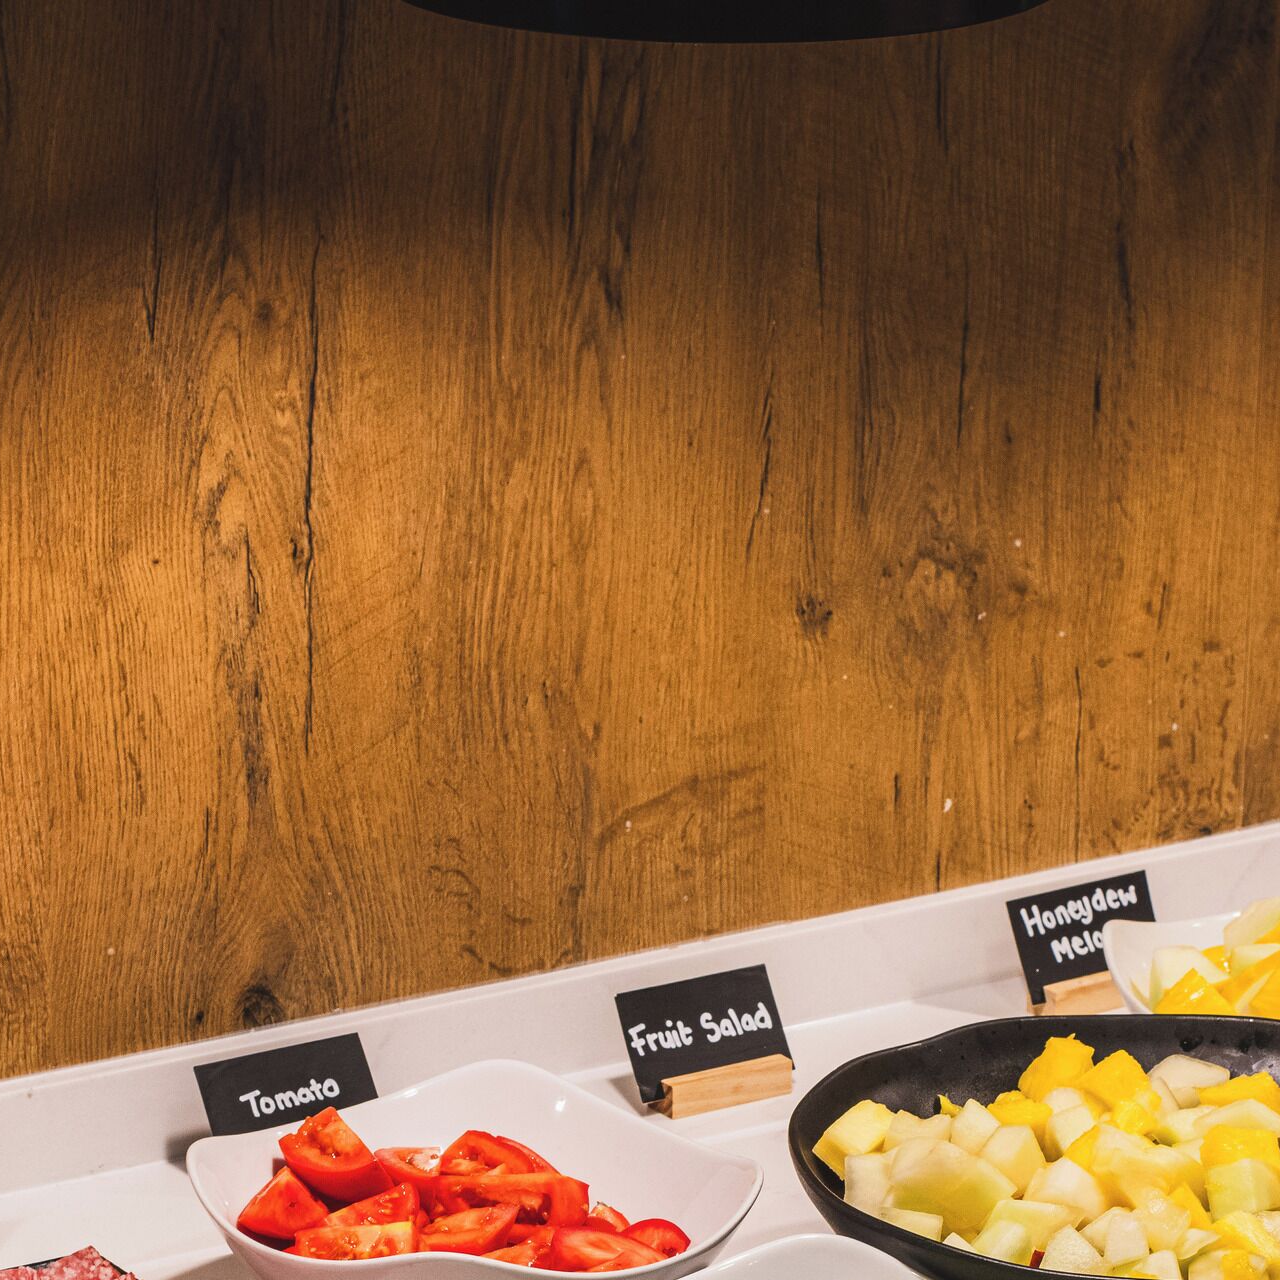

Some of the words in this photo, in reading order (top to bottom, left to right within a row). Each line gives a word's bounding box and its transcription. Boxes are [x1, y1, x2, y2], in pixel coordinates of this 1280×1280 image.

[1020, 884, 1138, 938] Honeydew
[1050, 930, 1104, 963] Melo
[628, 1019, 693, 1056] Fruit
[700, 1001, 773, 1043] Salad
[239, 1078, 341, 1118] Tomato
